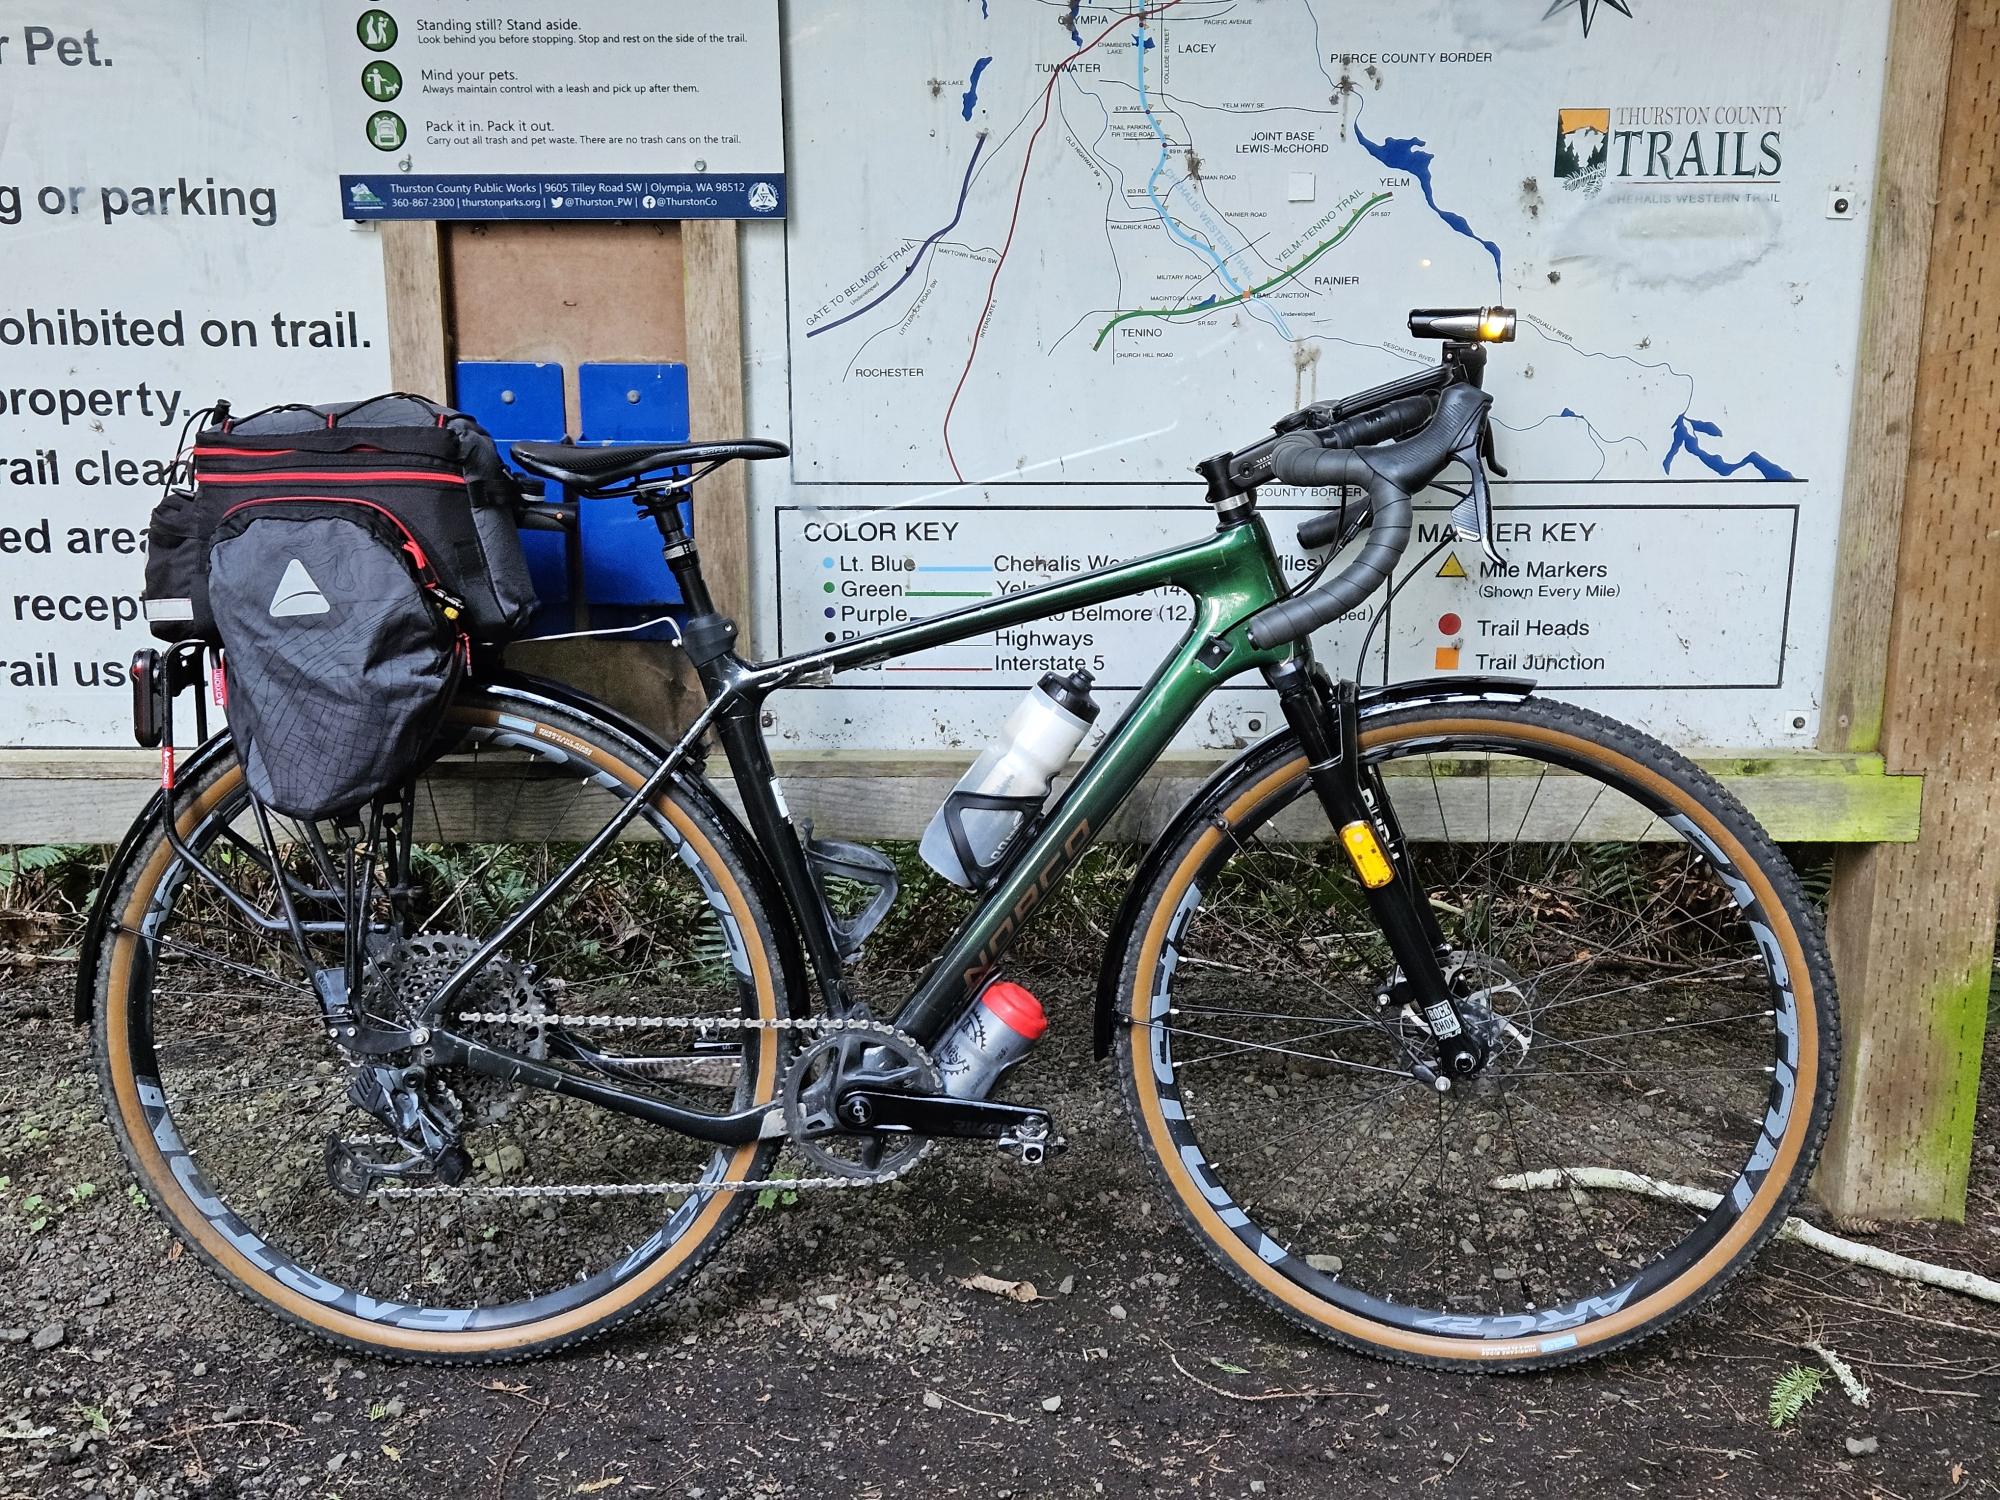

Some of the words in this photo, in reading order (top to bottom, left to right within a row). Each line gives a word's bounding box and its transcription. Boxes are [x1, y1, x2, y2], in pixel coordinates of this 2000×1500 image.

[416, 18, 472, 34] Standing
[475, 18, 503, 31] still?
[506, 18, 542, 31] Stand
[545, 18, 582, 31] aside.
[1058, 15, 1109, 25] OYMPIA
[24, 26, 113, 67] Pet.
[417, 34, 441, 44] Look
[443, 34, 476, 44] behind
[478, 36, 497, 47] you
[498, 33, 530, 44] before
[531, 33, 576, 46] stopping.
[578, 33, 600, 46] Stop
[602, 33, 621, 44] and
[622, 34, 641, 44] rest
[642, 35, 656, 44] on
[657, 33, 674, 43] the
[675, 33, 695, 43] side
[697, 33, 707, 43] of
[709, 33, 725, 43] the
[726, 33, 748, 43] trail.
[1178, 43, 1217, 54] LACEY
[1330, 53, 1378, 64] PIERCE
[1381, 53, 1436, 63] COUNTY
[1439, 52, 1493, 63] BORDER
[421, 68, 453, 81] Mind
[456, 71, 486, 84] your
[488, 69, 518, 84] pets.
[1034, 63, 1101, 73] TUMWATER
[422, 84, 455, 96] Always
[456, 83, 498, 94] maintain
[499, 84, 533, 94] control
[534, 83, 555, 94] with
[565, 83, 590, 93] leash
[592, 83, 610, 93] and
[612, 83, 632, 96] pick
[633, 85, 647, 96] up
[648, 83, 671, 93] after
[672, 83, 700, 93] them.
[1615, 106, 1710, 126] THURSTON
[1714, 106, 1787, 126] COUNTY
[425, 120, 455, 132] Pack
[457, 120, 466, 132] it
[469, 119, 484, 132] in.
[487, 119, 516, 132] Pack
[518, 119, 527, 132] it
[530, 121, 554, 132] out.
[426, 135, 452, 148] Carry
[453, 136, 470, 145] out
[472, 135, 483, 145] all
[484, 135, 509, 145] trash
[510, 135, 529, 145] and
[530, 136, 547, 147] pet
[548, 136, 578, 145] waste.
[579, 135, 607, 145] There
[639, 135, 664, 144] trash
[665, 136, 687, 144] cans
[688, 136, 702, 144] on
[703, 134, 719, 144] the
[721, 134, 741, 144] trail.
[1250, 132, 1283, 142] JOINT
[1285, 132, 1315, 141] BASE
[1235, 143, 1329, 154] LEWIS-McCHORD
[1613, 130, 1783, 180] TRAILS
[389, 183, 434, 194] Thurston
[435, 183, 472, 196] County
[473, 182, 504, 193] Public
[505, 182, 537, 193] Works
[544, 182, 569, 193] 9605
[570, 182, 597, 195] Tilley
[598, 182, 624, 193] Road
[625, 182, 643, 194] SW
[650, 182, 694, 195] Olympia,
[695, 182, 714, 192] WA
[715, 182, 746, 193] 98512
[1379, 177, 1410, 187] YELM
[37, 185, 86, 215] or
[100, 177, 278, 226] parking
[391, 197, 455, 208] 360-867-2300
[461, 197, 541, 209] thurstonparks.org
[564, 196, 633, 210] @Thurston_PW
[656, 196, 718, 208] @ThurstonCo
[1274, 210, 1336, 263] YELM-TENINO
[1336, 188, 1364, 213] TRAIL
[806, 306, 829, 326] GATE
[844, 261, 888, 296] BELMORE
[887, 241, 916, 264] TRAIL
[1314, 276, 1360, 286] RAINIER
[200, 316, 258, 347] on
[271, 311, 372, 348] trail.
[1526, 313, 1557, 333] NISQUALLY
[1120, 328, 1163, 338] TENINO
[1382, 341, 1417, 357] DESCHUTES
[855, 367, 925, 378] ROCHESTER
[1256, 487, 1308, 498] COUNTY
[1310, 487, 1363, 498] BORDER
[803, 522, 897, 543] COLOR
[904, 521, 960, 542] KEY
[1418, 522, 1531, 544] MAER
[1542, 521, 1598, 543] KEY
[840, 556, 864, 572] Lt.
[993, 554, 1081, 573] Chehalis
[1479, 561, 1520, 578] Mile
[1526, 561, 1608, 578] Markers
[840, 580, 903, 598] Green
[1477, 583, 1534, 600] (Shown
[1537, 583, 1583, 600] Every
[1586, 583, 1622, 600] Mile)
[14, 590, 148, 631] recep
[840, 604, 908, 626] Purple
[1072, 605, 1153, 622] Belmore
[1478, 619, 1520, 637] Trail
[1525, 619, 1590, 637] Heads
[994, 630, 1094, 649] Highways
[994, 655, 1087, 671] Interstate
[1094, 656, 1105, 671] 5
[1476, 653, 1518, 671] Trail
[1522, 652, 1606, 671] Junction
[963, 817, 1089, 988] NORCO
[1427, 1003, 1451, 1020] ROCK
